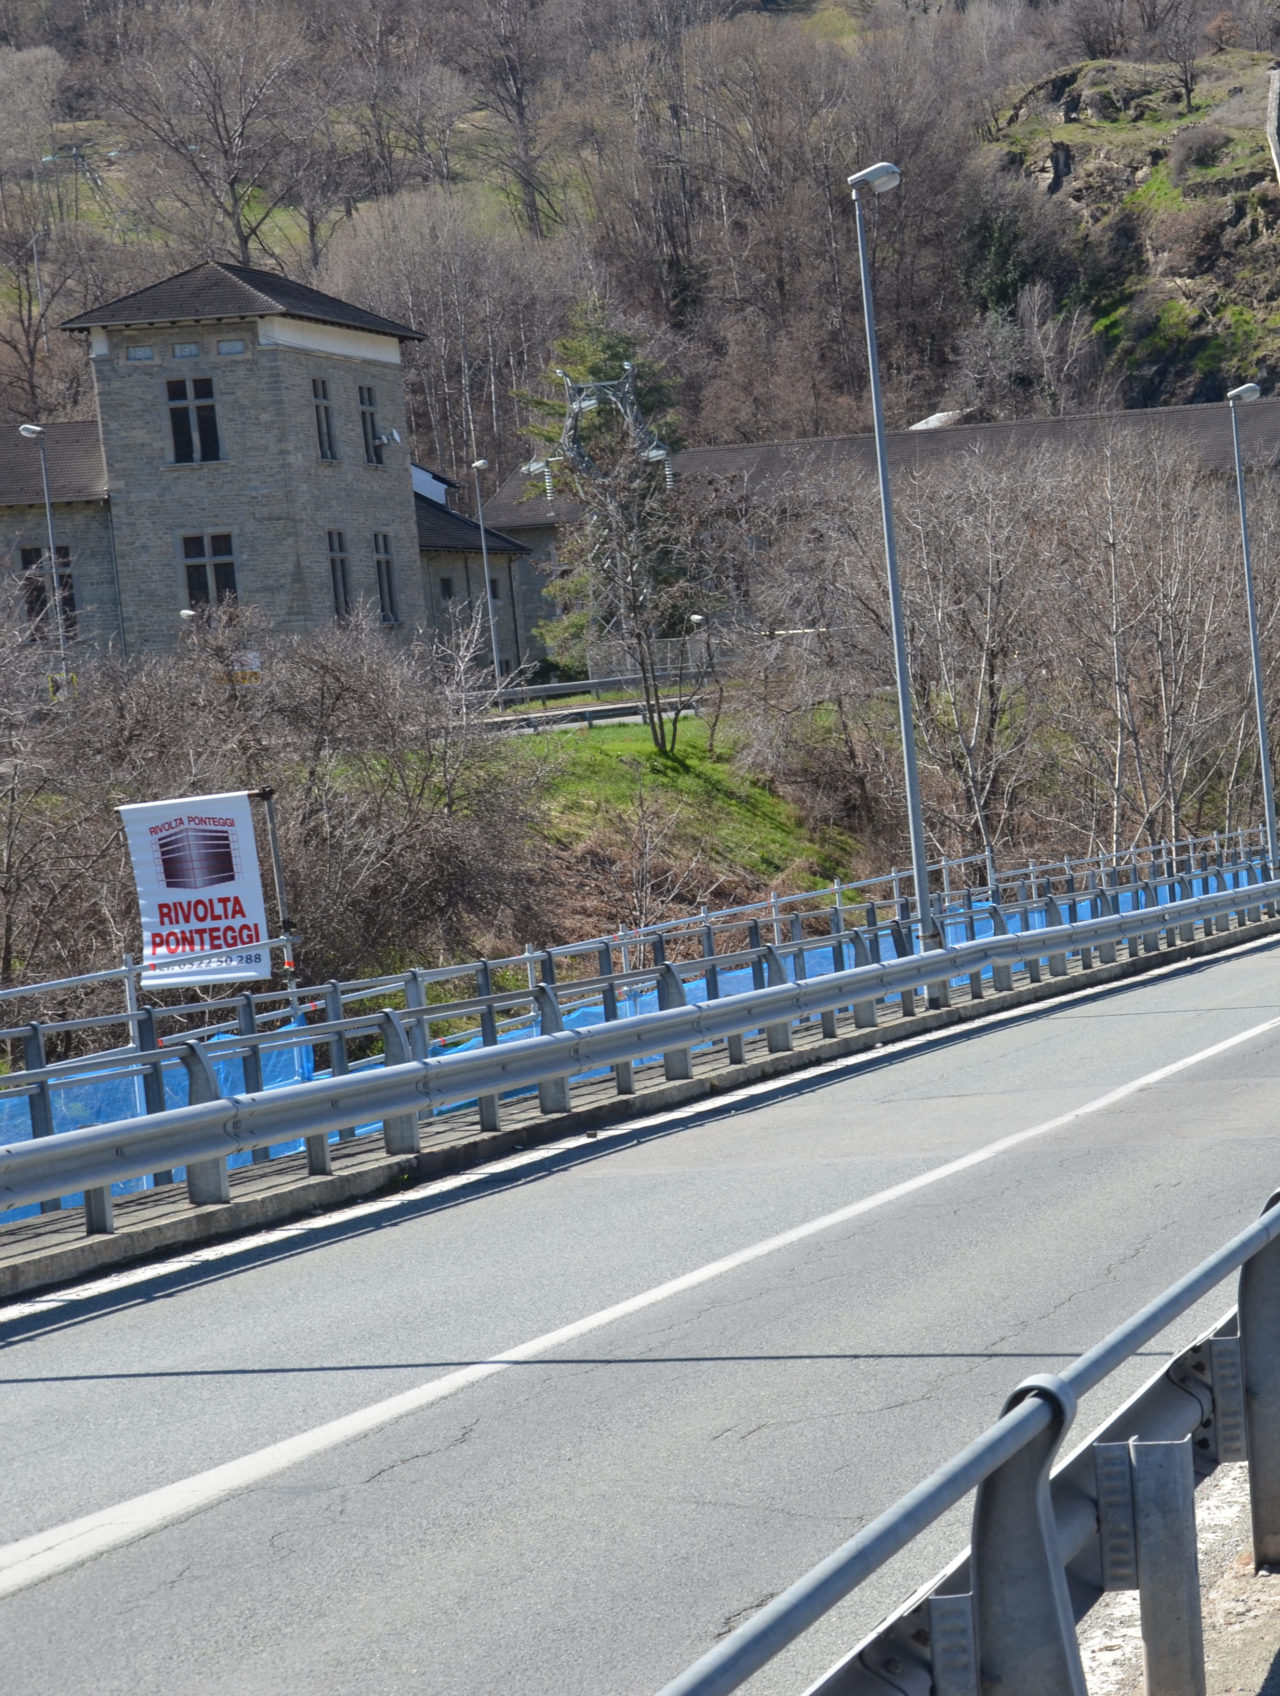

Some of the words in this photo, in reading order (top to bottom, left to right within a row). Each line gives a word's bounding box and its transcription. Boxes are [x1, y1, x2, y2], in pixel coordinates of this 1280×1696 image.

[149, 817, 185, 836] RIVOLTA
[187, 816, 235, 828] PONTEGGI
[158, 896, 246, 926] RIVOLTA
[151, 923, 260, 956] PONTEGGI
[216, 955, 233, 967] 50
[237, 953, 262, 965] 288
